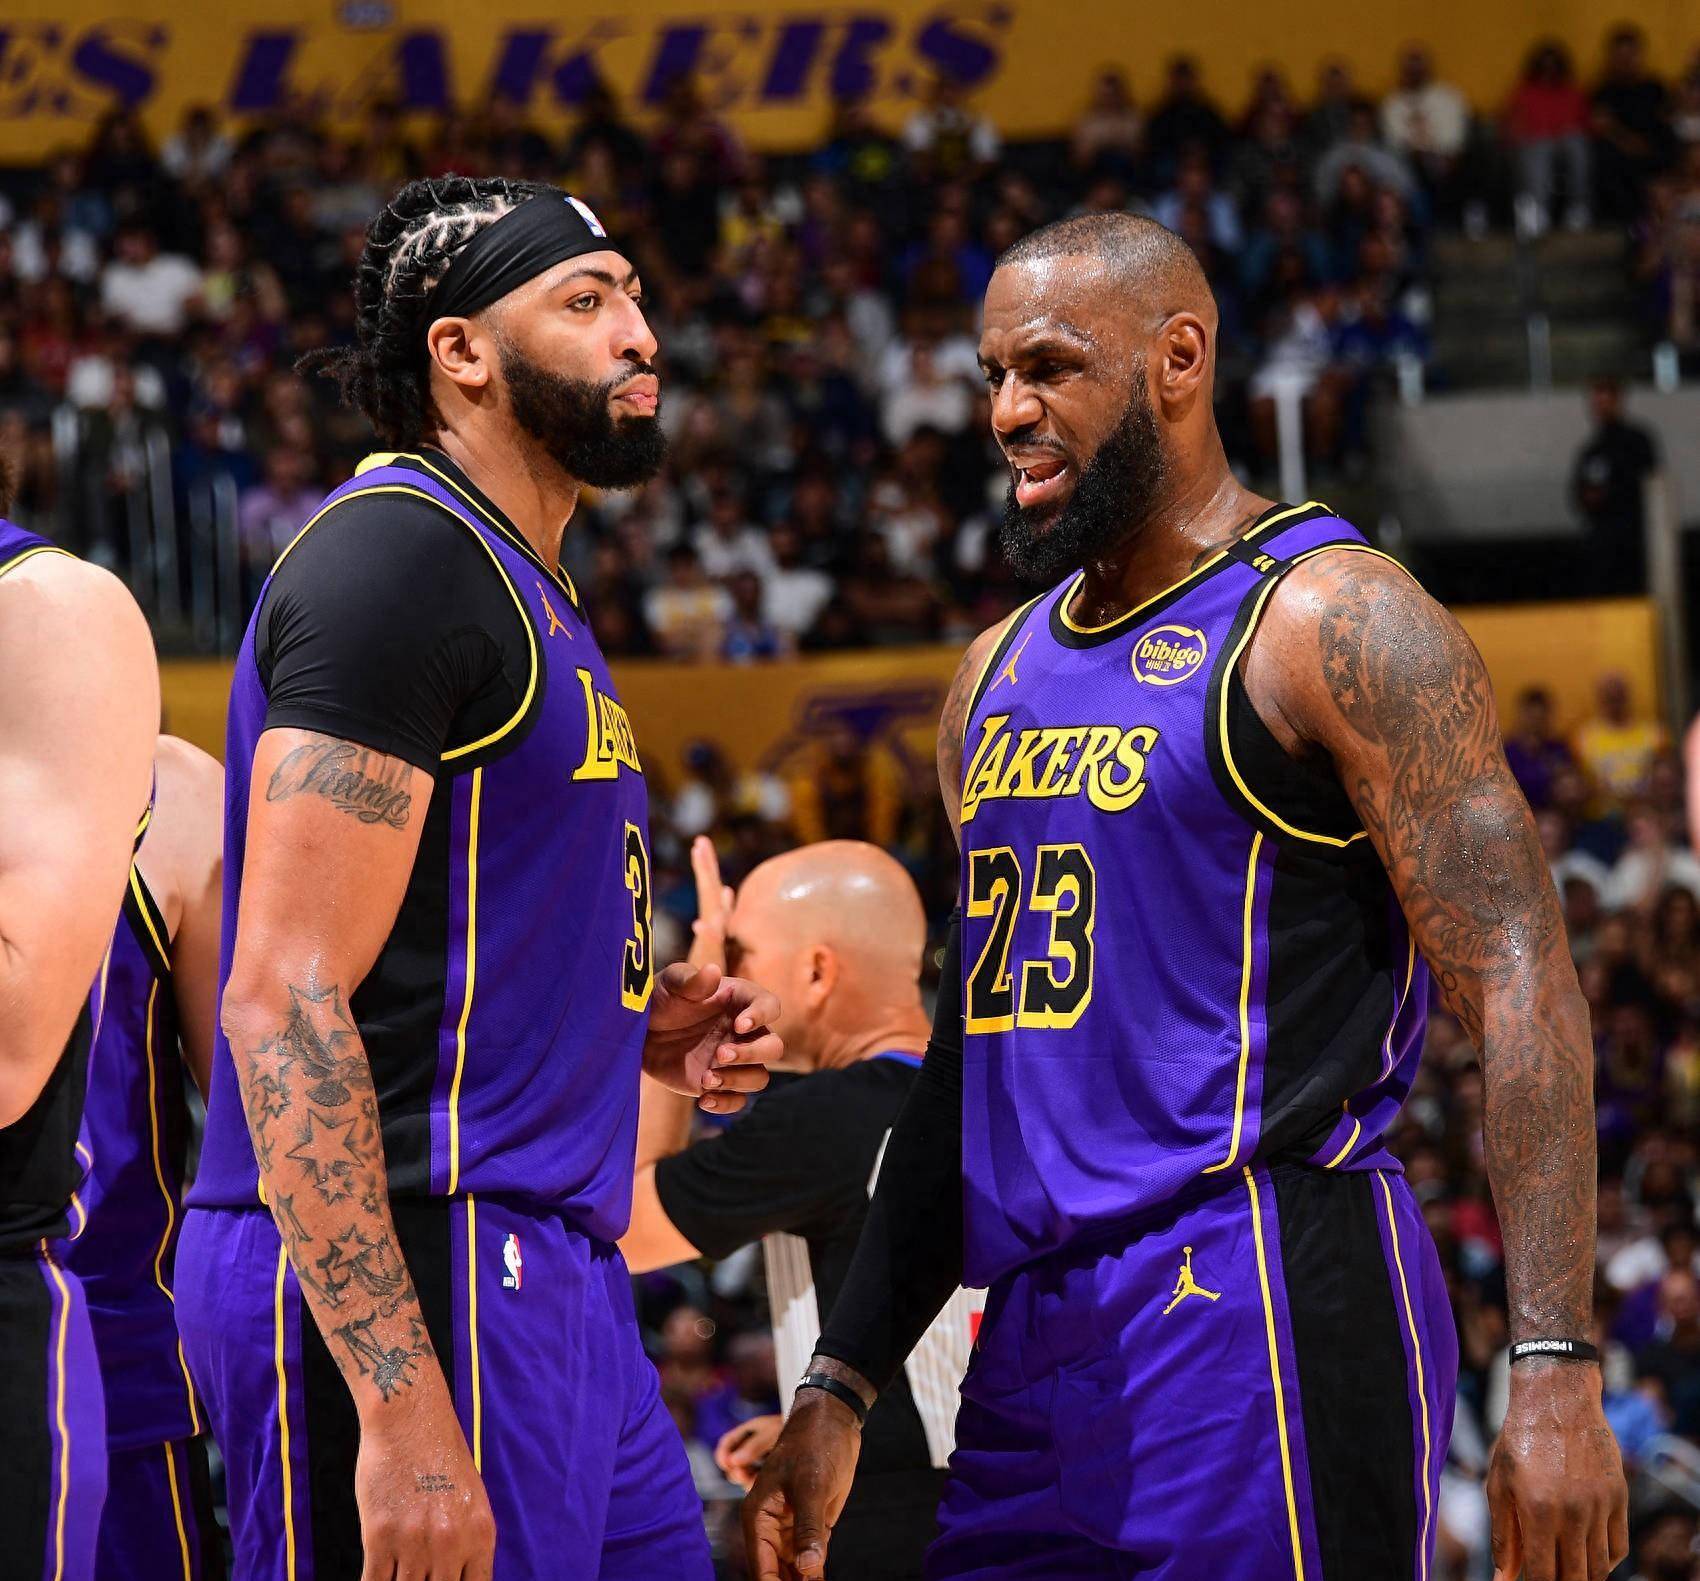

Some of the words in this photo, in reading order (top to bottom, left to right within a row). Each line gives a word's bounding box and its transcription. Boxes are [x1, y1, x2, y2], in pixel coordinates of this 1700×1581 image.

[224, 4, 1012, 116] LAKERS
[1139, 639, 1201, 670] bibigo
[961, 713, 1160, 826] LAKERS
[965, 842, 1096, 1035] 23
[1515, 1340, 1567, 1355] PROMISE
